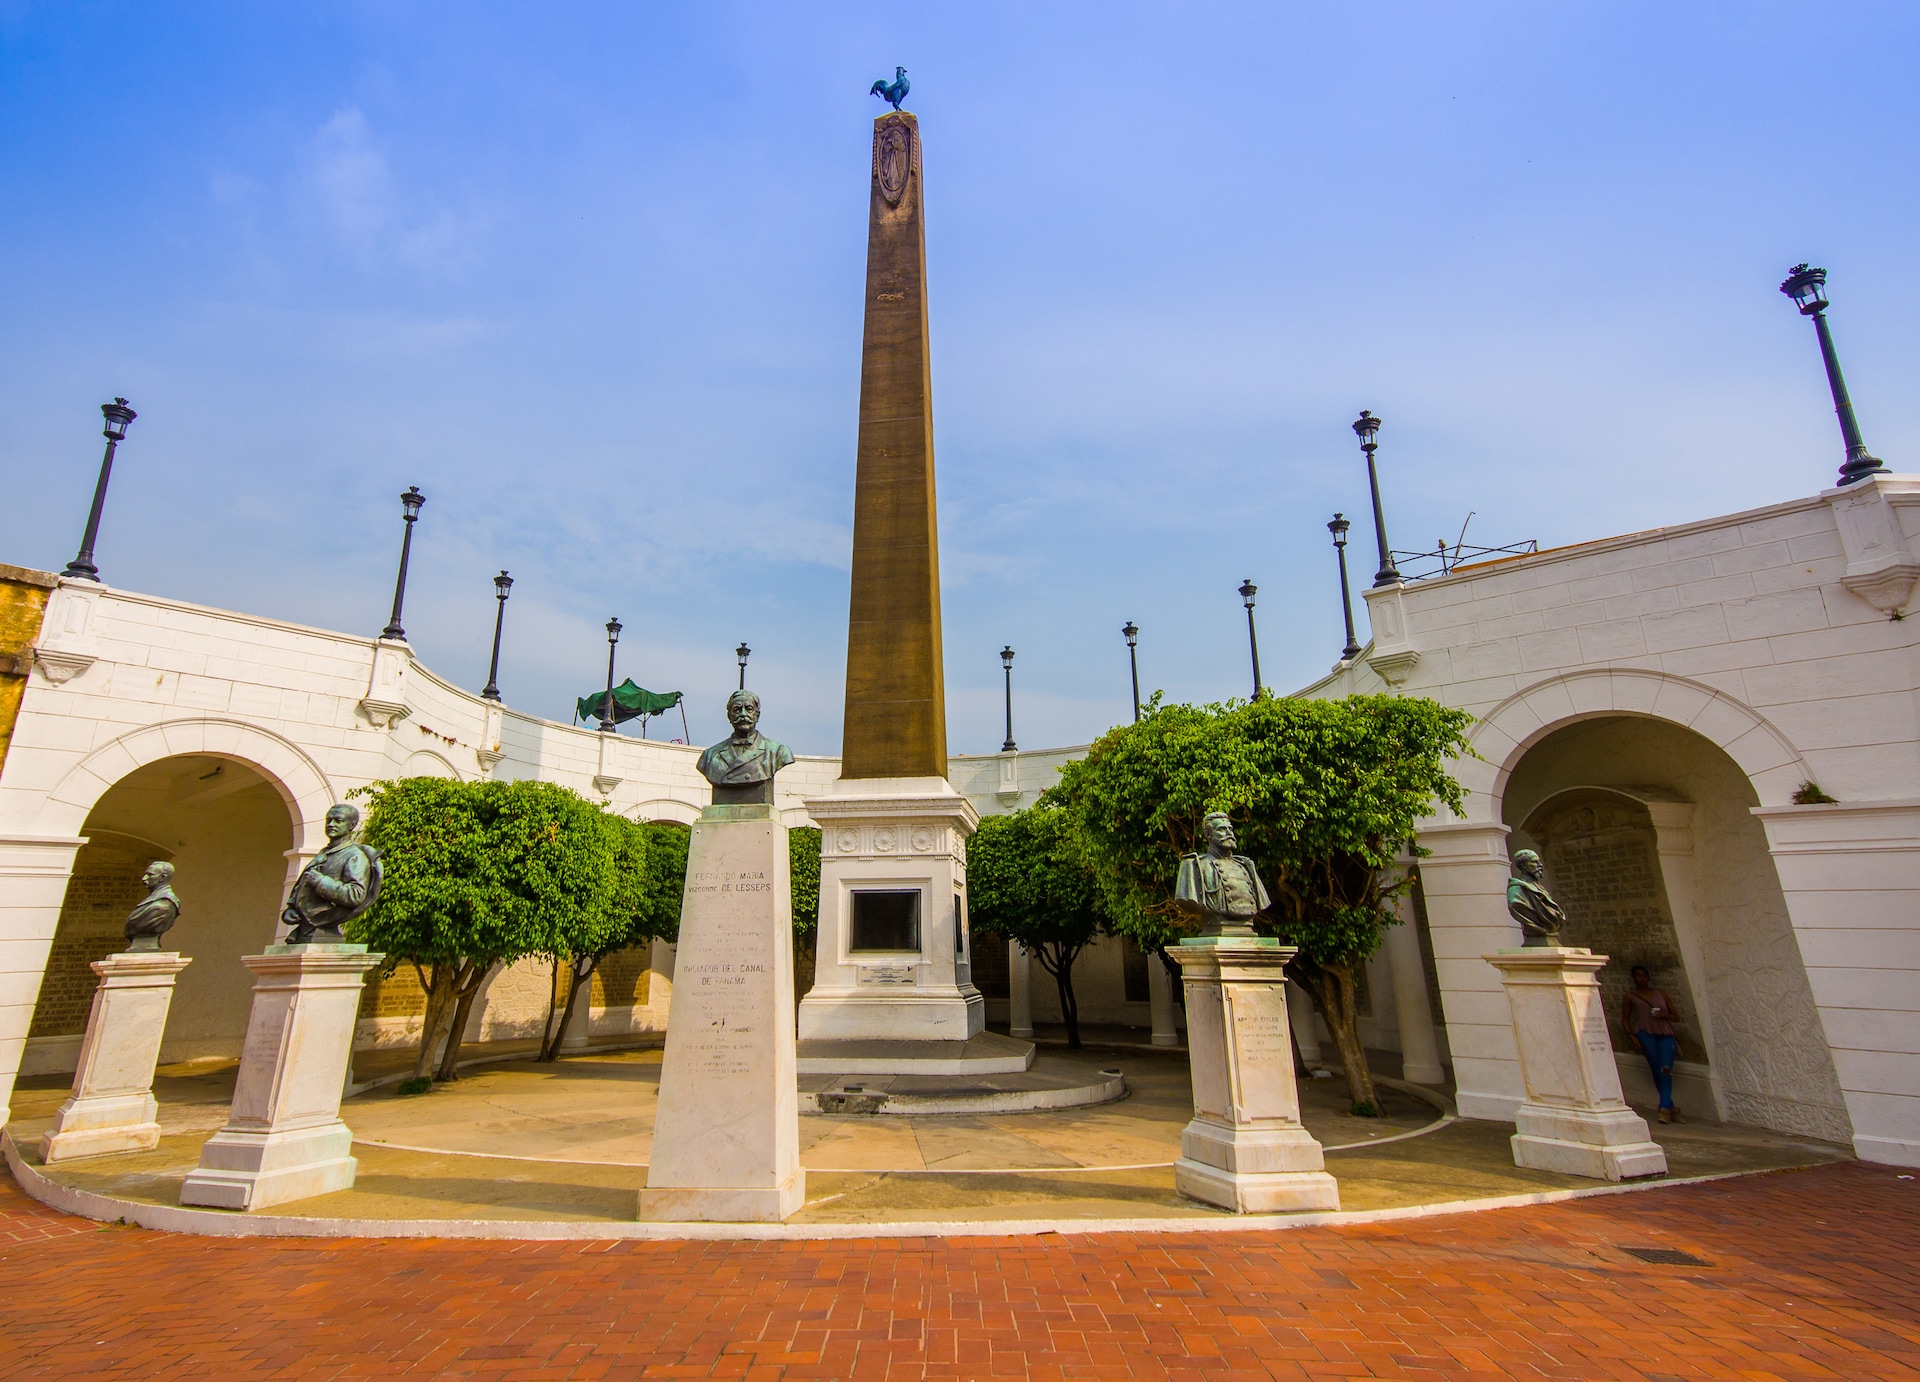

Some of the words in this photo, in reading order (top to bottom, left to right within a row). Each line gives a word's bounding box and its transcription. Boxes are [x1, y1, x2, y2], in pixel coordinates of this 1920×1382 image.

[695, 872, 736, 881] FERNANDO
[740, 872, 765, 880] MARIA
[722, 884, 732, 892] DE
[735, 883, 771, 892] LESSEPS
[722, 964, 736, 972] DEL
[740, 964, 766, 973] CANAL
[702, 977, 711, 986] DE
